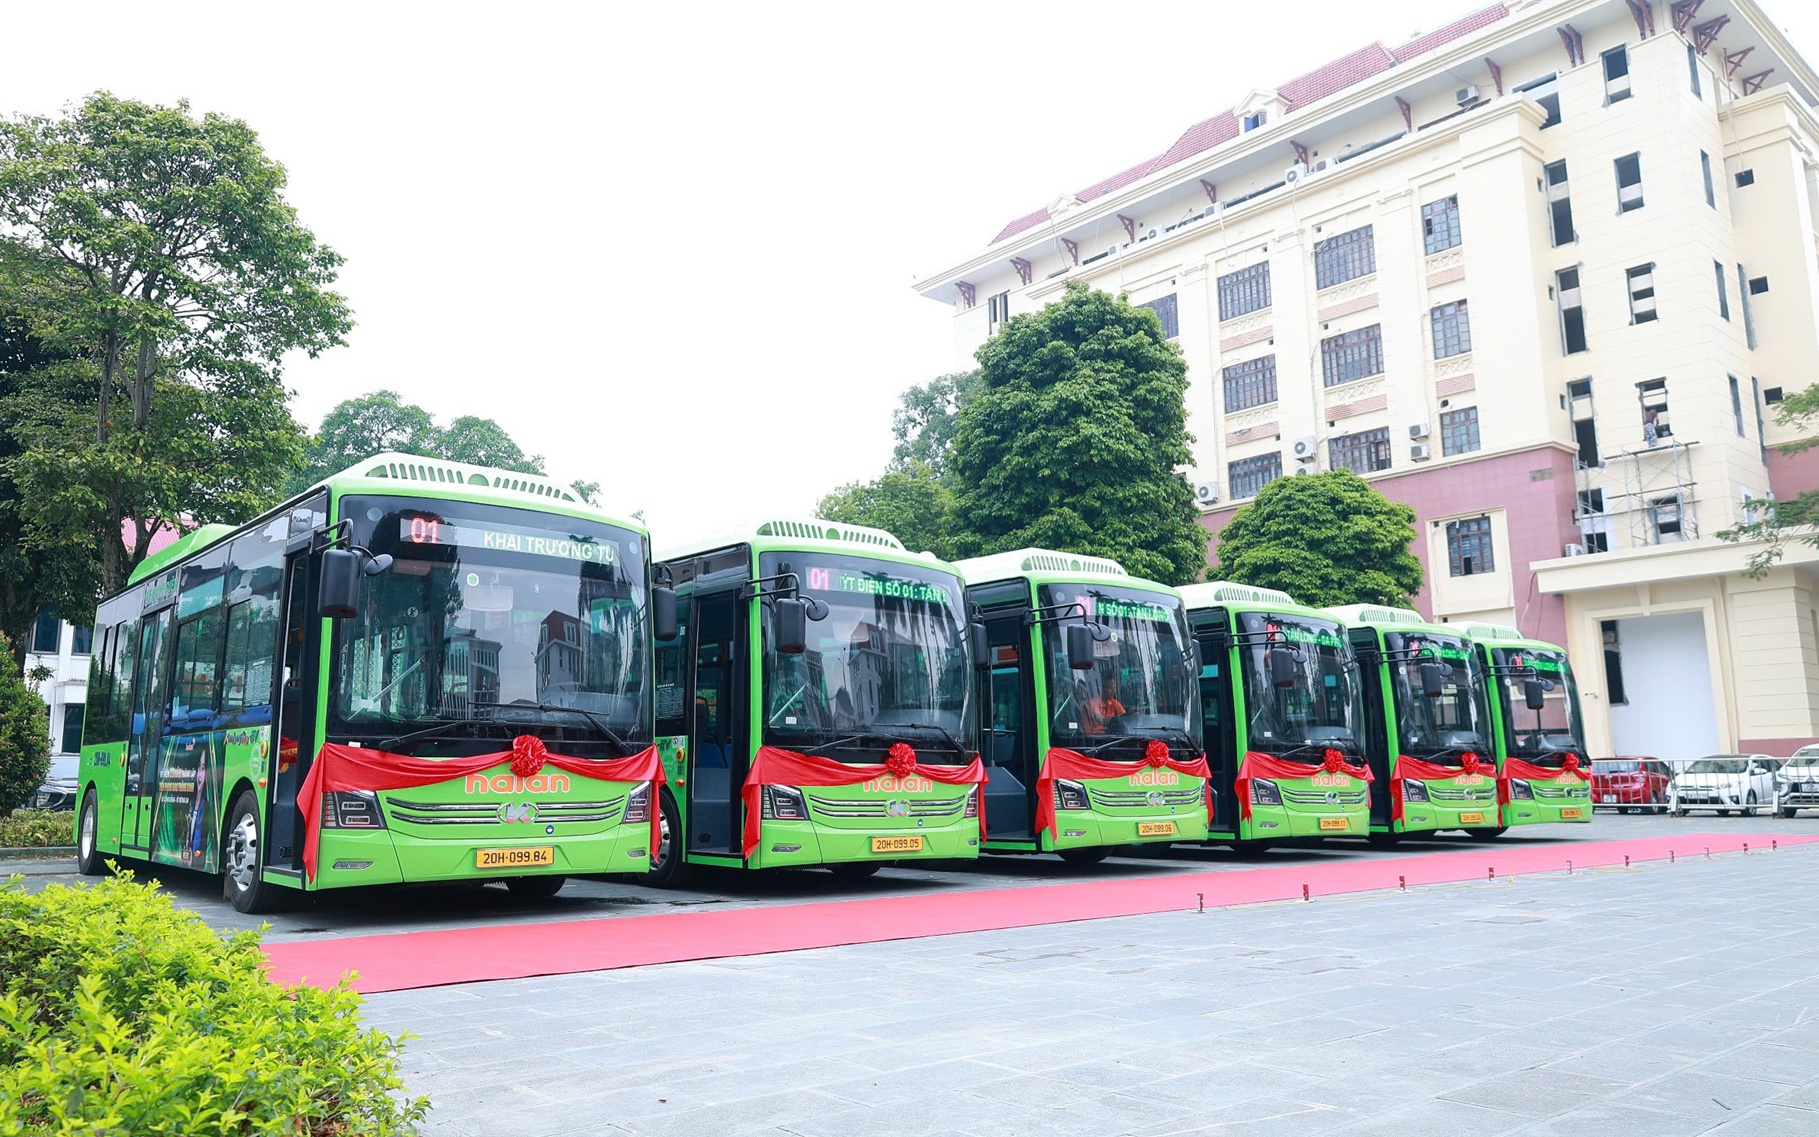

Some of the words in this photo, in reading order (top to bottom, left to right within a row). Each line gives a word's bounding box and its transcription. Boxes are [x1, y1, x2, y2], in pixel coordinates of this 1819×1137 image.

[410, 517, 440, 545] 01
[484, 531, 521, 551] KHAI
[810, 567, 830, 591] 01
[876, 838, 919, 850] 20H-099.05
[483, 850, 547, 865] 20H-099.84
